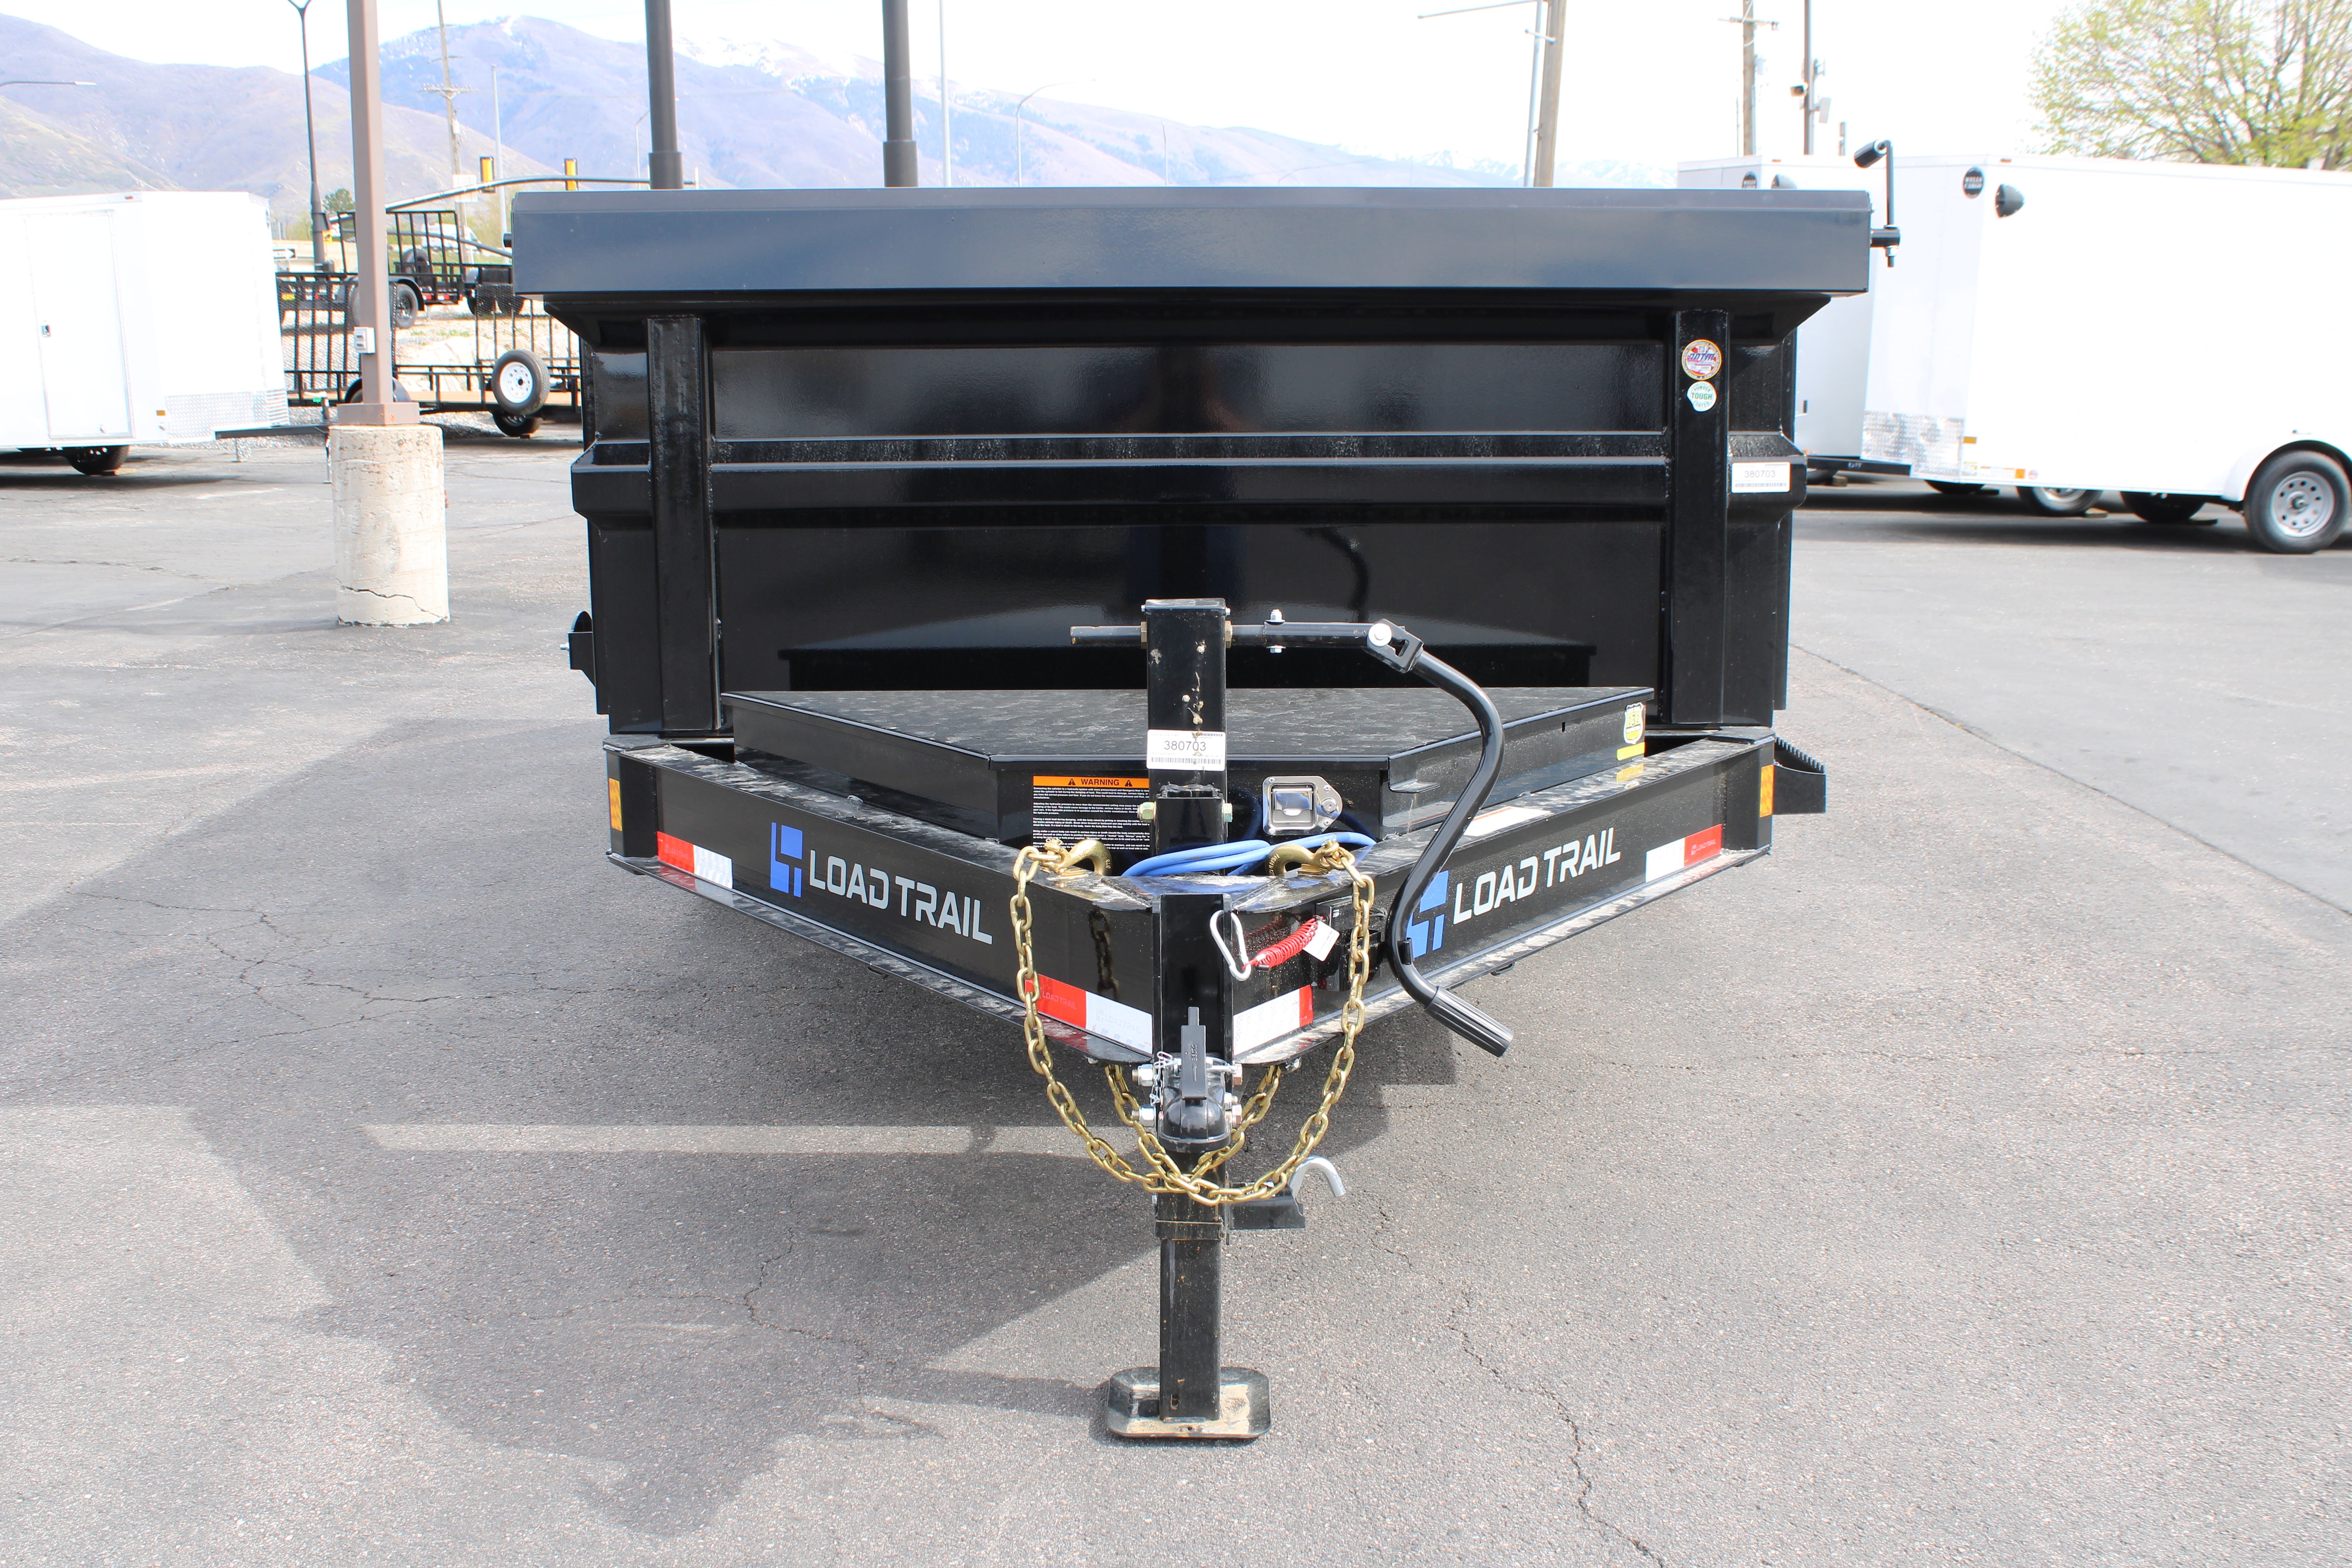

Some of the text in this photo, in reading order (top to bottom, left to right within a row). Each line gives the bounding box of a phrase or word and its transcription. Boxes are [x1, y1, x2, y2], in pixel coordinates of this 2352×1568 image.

[1744, 470, 1775, 478] 380703
[1164, 740, 1206, 751] 380703
[1453, 827, 1621, 924] LOAD TRAIL
[809, 850, 992, 944] LOAD TRAIL
[1042, 991, 1077, 1009] LOAD TRAIL
[1105, 1014, 1141, 1034] LOAD TRAIL
